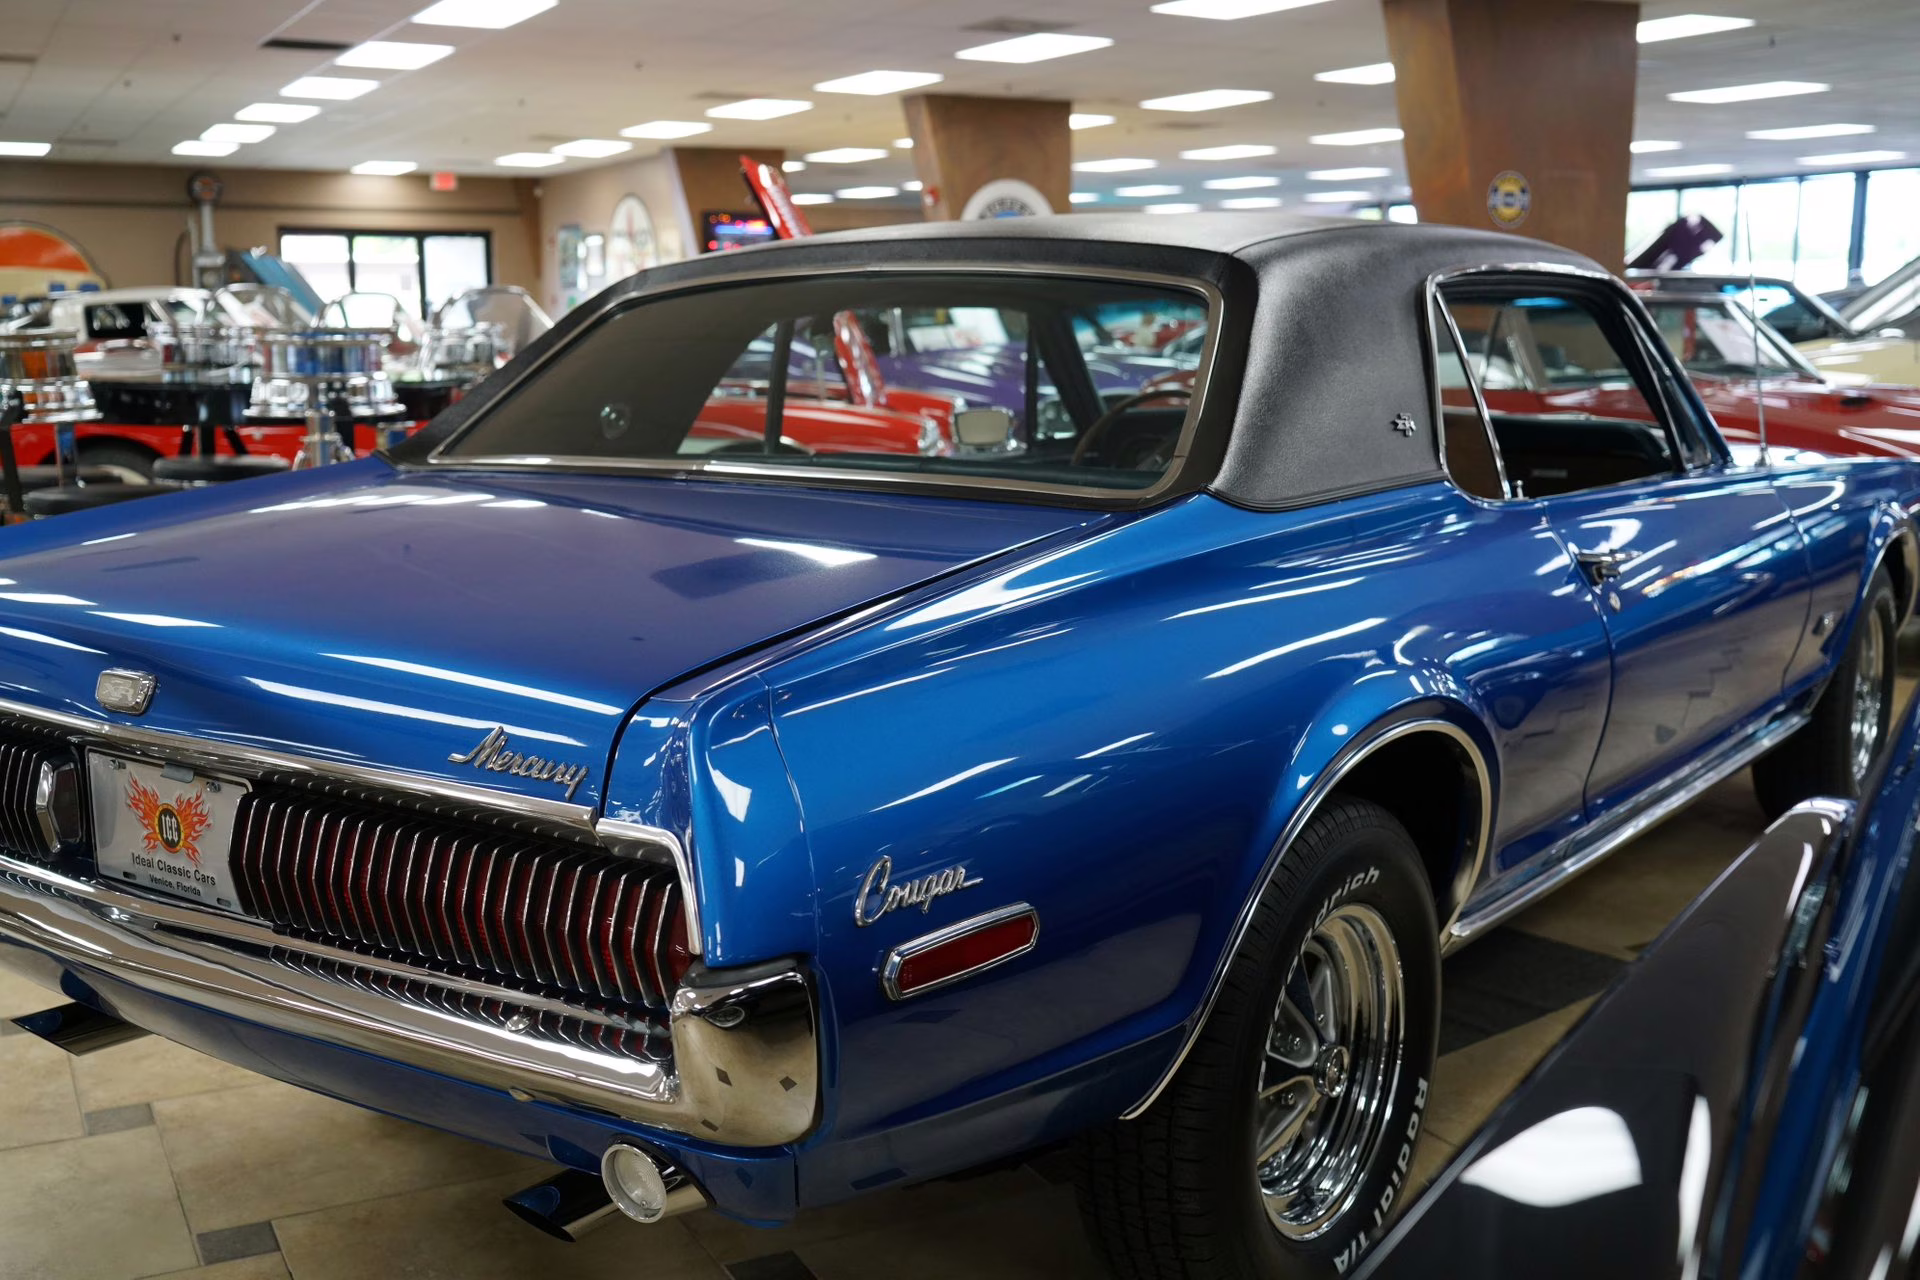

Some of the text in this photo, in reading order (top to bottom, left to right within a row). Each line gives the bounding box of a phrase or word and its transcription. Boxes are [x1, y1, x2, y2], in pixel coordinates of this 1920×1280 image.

[448, 725, 589, 800] Mercury
[161, 814, 179, 843] ICC
[131, 852, 217, 886] Ideal Classic Cars
[149, 873, 202, 897] Venice, Florida
[854, 855, 984, 928] Cougar
[1373, 1077, 1429, 1228] Radial
